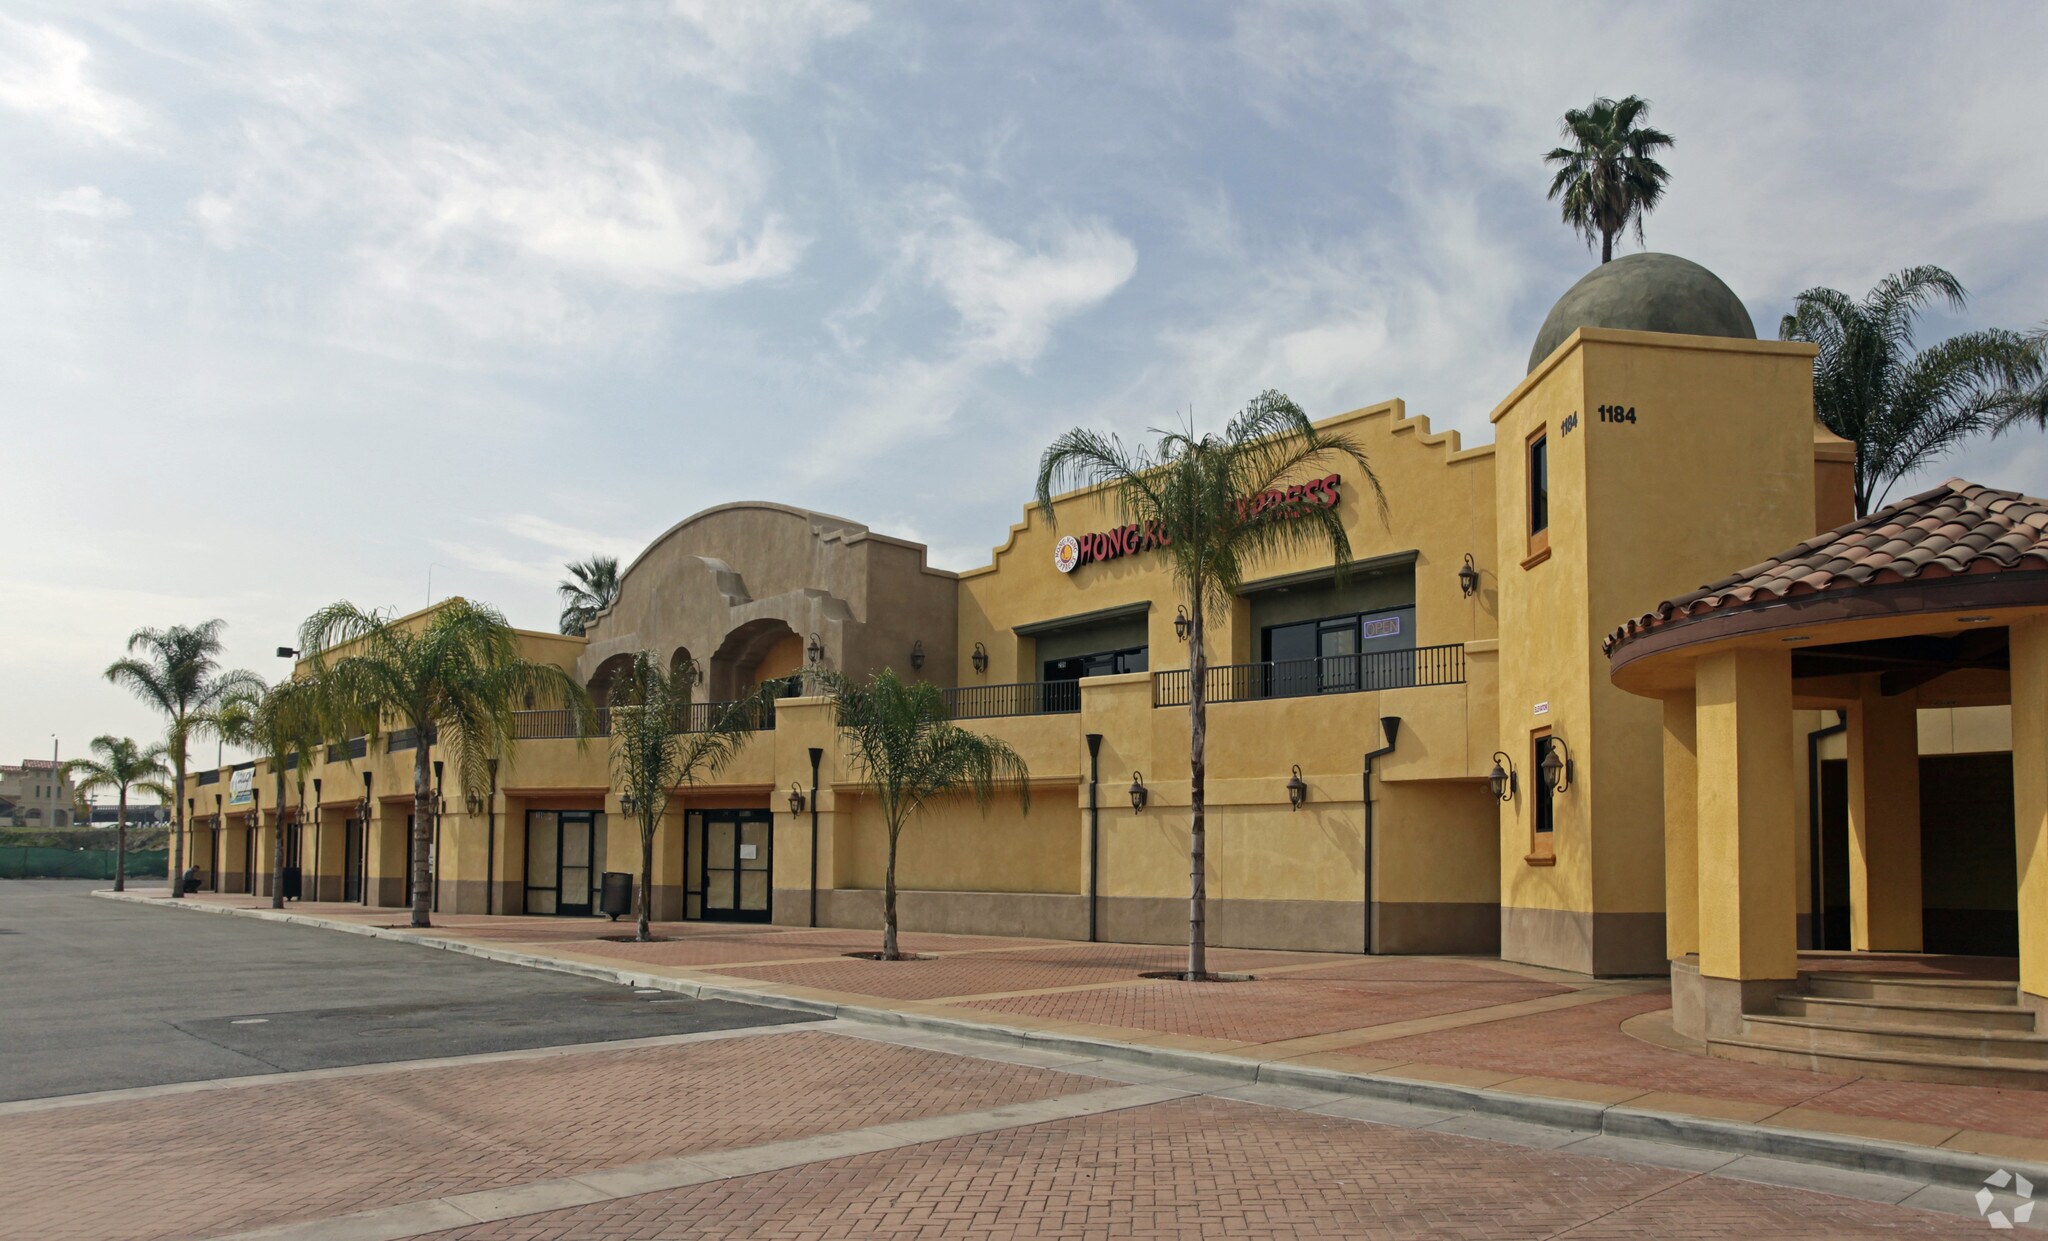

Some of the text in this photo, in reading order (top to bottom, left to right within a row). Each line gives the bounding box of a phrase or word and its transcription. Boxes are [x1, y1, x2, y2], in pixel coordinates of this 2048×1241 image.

[1561, 410, 1578, 438] 1184
[1598, 405, 1637, 425] 1184
[1080, 523, 1142, 565] HONG
[1366, 620, 1398, 636] OPEN
